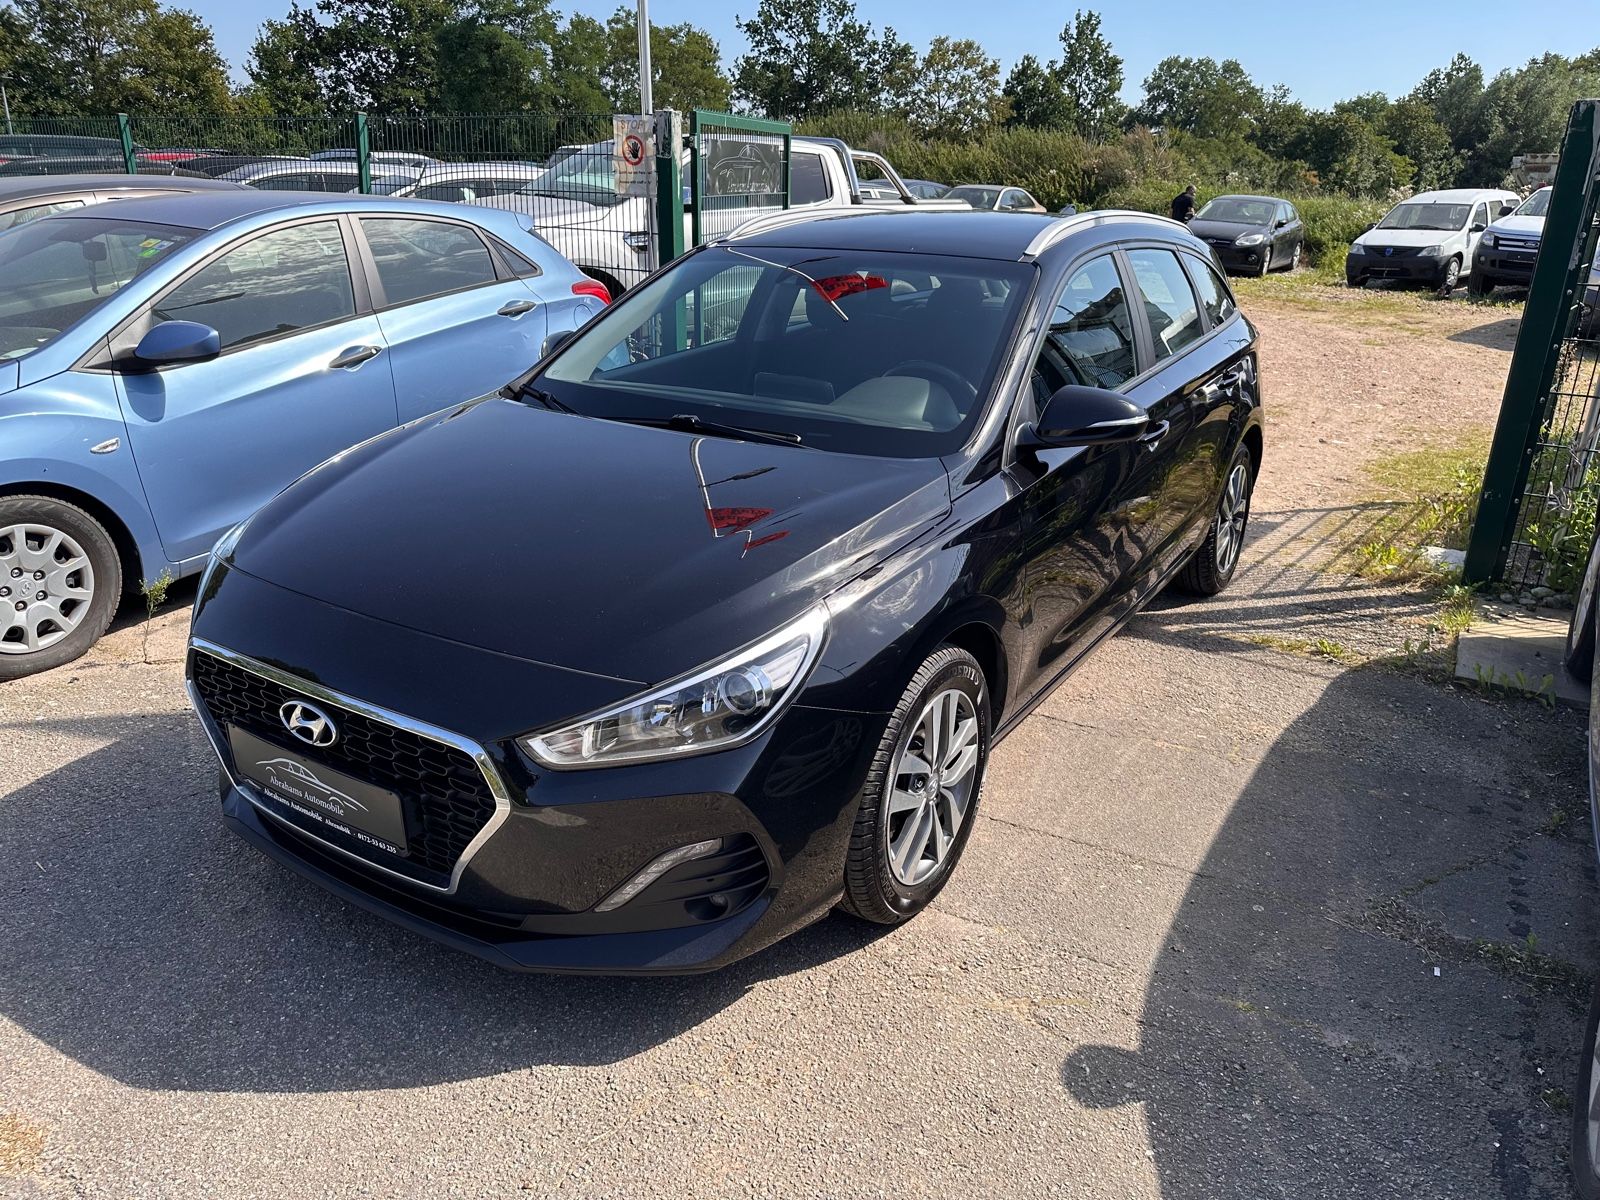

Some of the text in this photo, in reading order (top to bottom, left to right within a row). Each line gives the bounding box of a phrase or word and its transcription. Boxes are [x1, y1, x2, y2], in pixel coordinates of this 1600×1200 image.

[620, 119, 645, 130] STOP
[270, 775, 344, 816] Abrahams Automobile
[290, 801, 323, 822] Automobile
